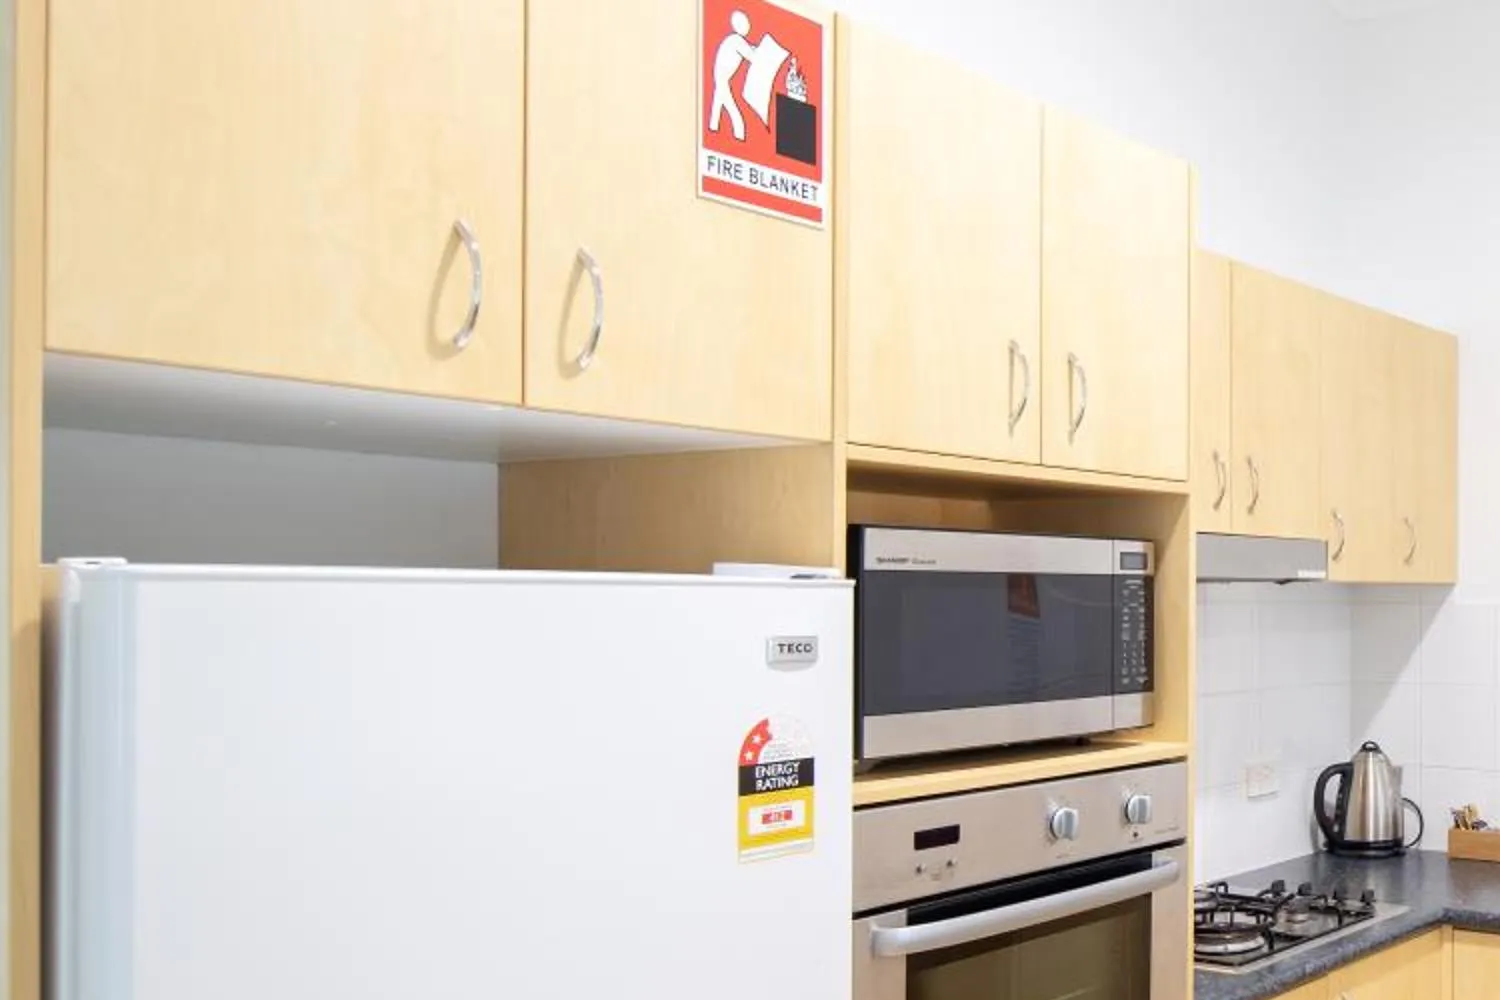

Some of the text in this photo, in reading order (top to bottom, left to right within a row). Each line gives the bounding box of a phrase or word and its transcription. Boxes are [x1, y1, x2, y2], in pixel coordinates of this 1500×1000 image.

[707, 155, 818, 202] FIRE BLANKET
[777, 642, 813, 654] TECO
[755, 761, 800, 779] ENERGY
[755, 773, 799, 791] RATING
